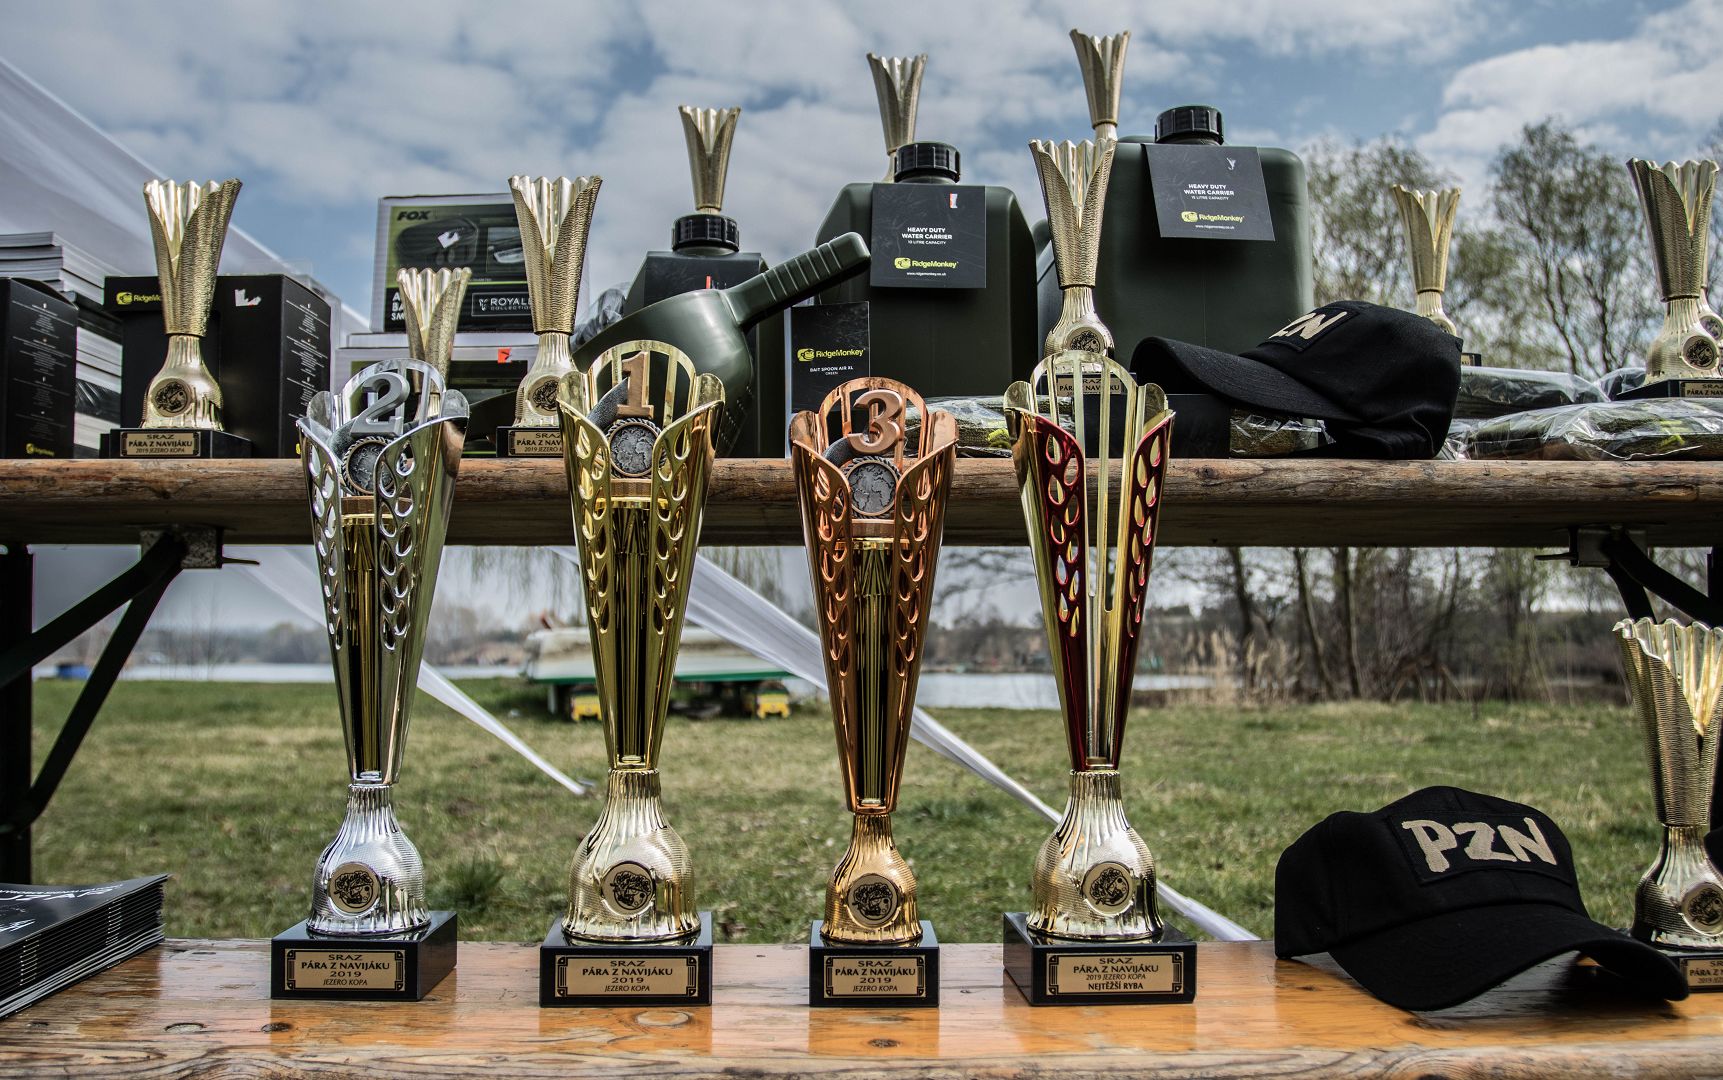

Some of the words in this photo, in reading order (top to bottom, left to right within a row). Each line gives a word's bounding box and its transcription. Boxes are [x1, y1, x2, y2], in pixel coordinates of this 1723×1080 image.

[397, 210, 430, 221] FOX
[1199, 214, 1243, 223] RidgeMonkey
[912, 260, 957, 269] RidgeMonkey
[816, 349, 863, 358] RidgeMonkey
[617, 352, 654, 419] 1
[350, 372, 410, 437] 2
[847, 390, 902, 454] 3
[1402, 817, 1557, 872] PZN
[301, 960, 327, 969] PÁRA
[340, 961, 390, 970] NAVIJÁKU
[1074, 965, 1099, 973] PÁRA
[1111, 964, 1158, 973] NAVIJÁKU
[582, 967, 609, 975] PÁRA
[622, 967, 673, 976] NAVIJÁKU
[835, 967, 859, 975] PÁRA
[870, 967, 916, 976] NAVIJÁKU
[1088, 981, 1121, 990] NEJTĚŽŠÍ
